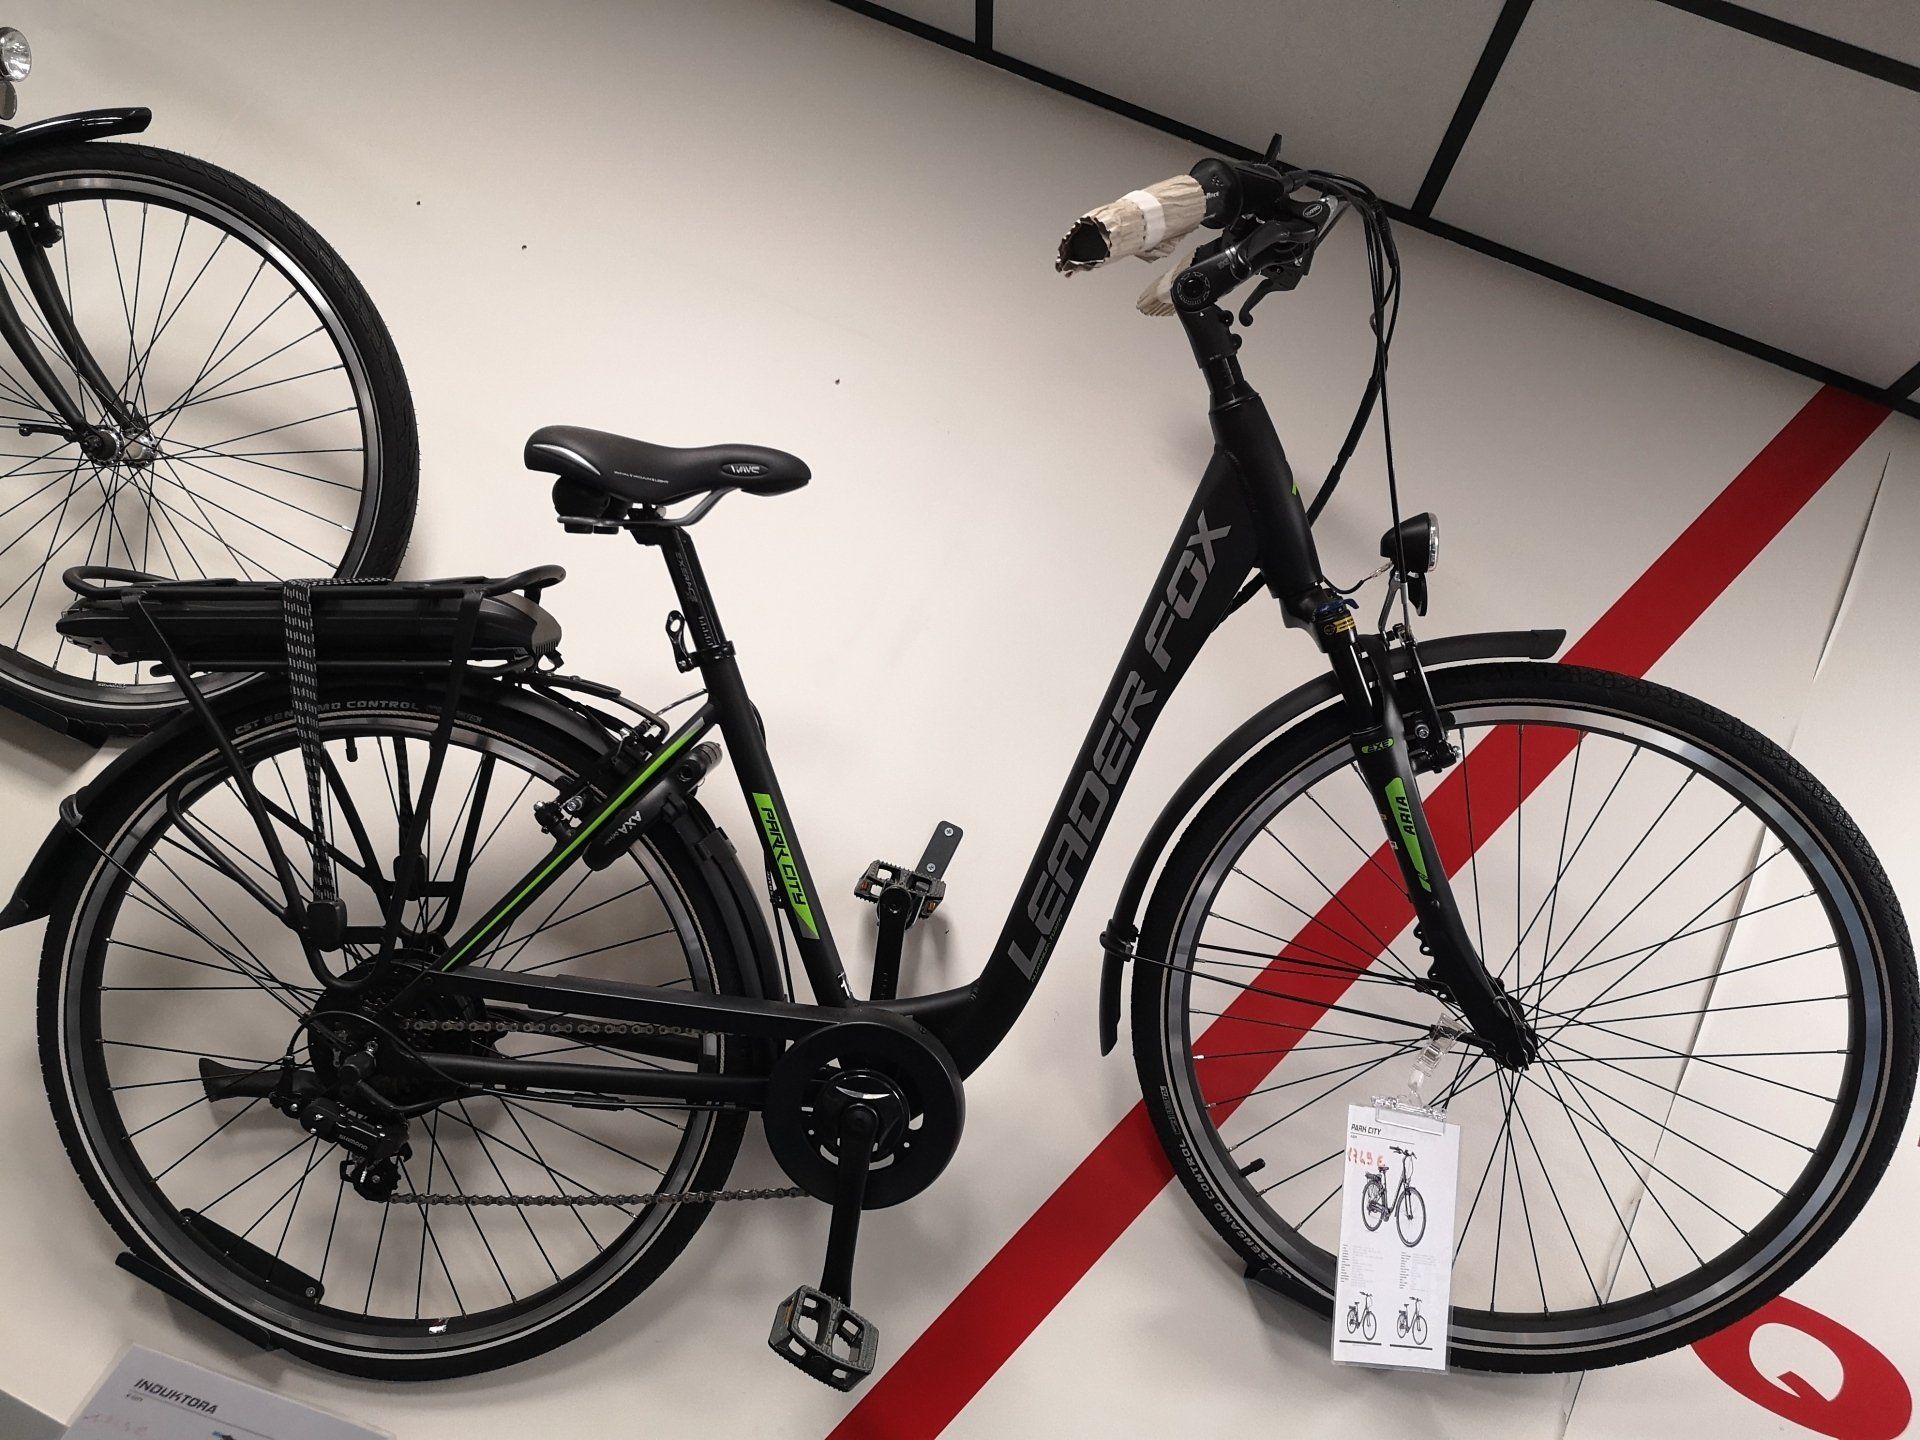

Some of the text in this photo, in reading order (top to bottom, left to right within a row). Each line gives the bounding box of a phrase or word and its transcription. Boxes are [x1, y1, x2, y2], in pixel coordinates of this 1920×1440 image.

[346, 700, 419, 710] CONTROL
[1007, 510, 1232, 982] LEADER FOX
[617, 810, 642, 834] AXA
[1401, 796, 1416, 836] ARIA
[761, 807, 789, 863] PARK
[783, 864, 807, 905] CITY
[1350, 1123, 1382, 1136] PARK CITY
[1178, 1139, 1216, 1201] CONTROL
[134, 1378, 219, 1415] INDUKTORA
